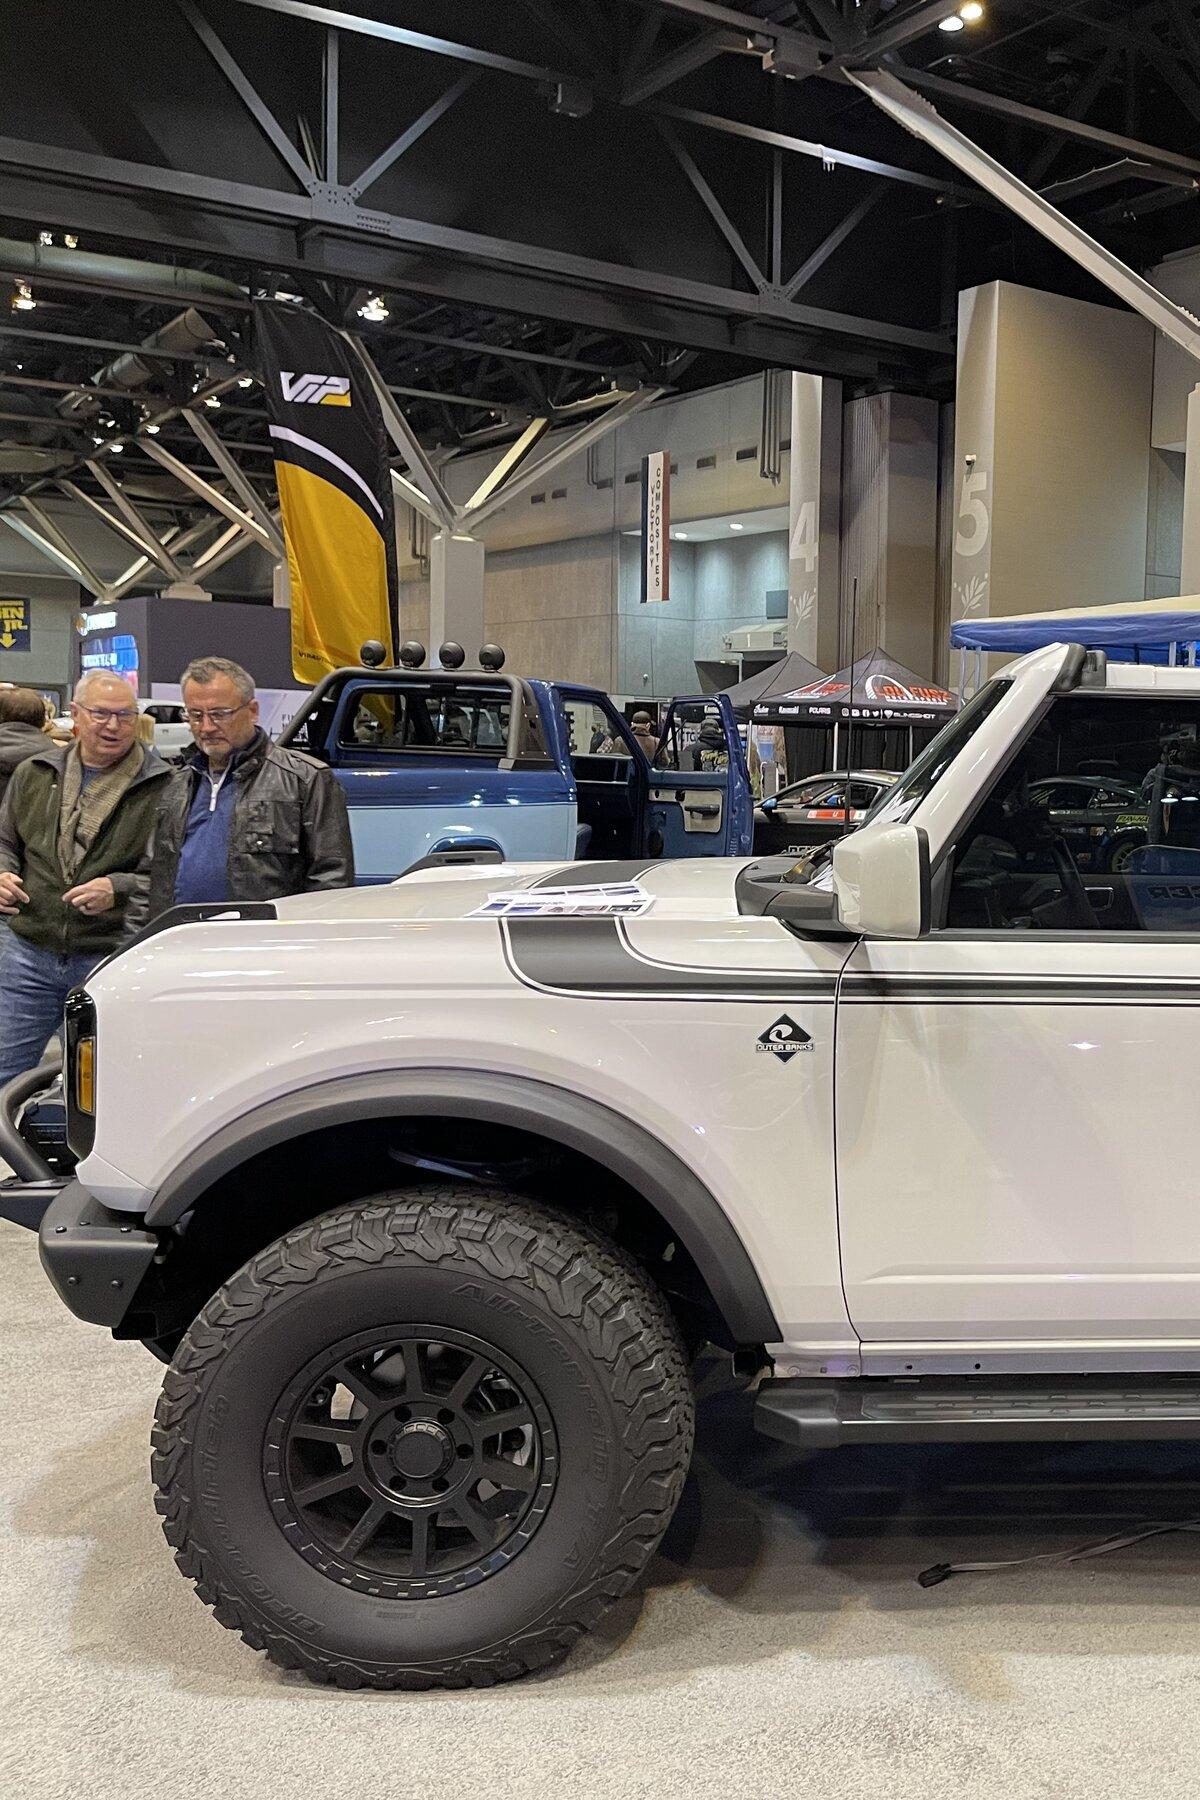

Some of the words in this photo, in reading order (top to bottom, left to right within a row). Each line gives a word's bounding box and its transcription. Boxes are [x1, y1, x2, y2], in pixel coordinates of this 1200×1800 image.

[280, 371, 351, 405] VIP
[790, 501, 819, 572] 4
[955, 472, 988, 556] 5
